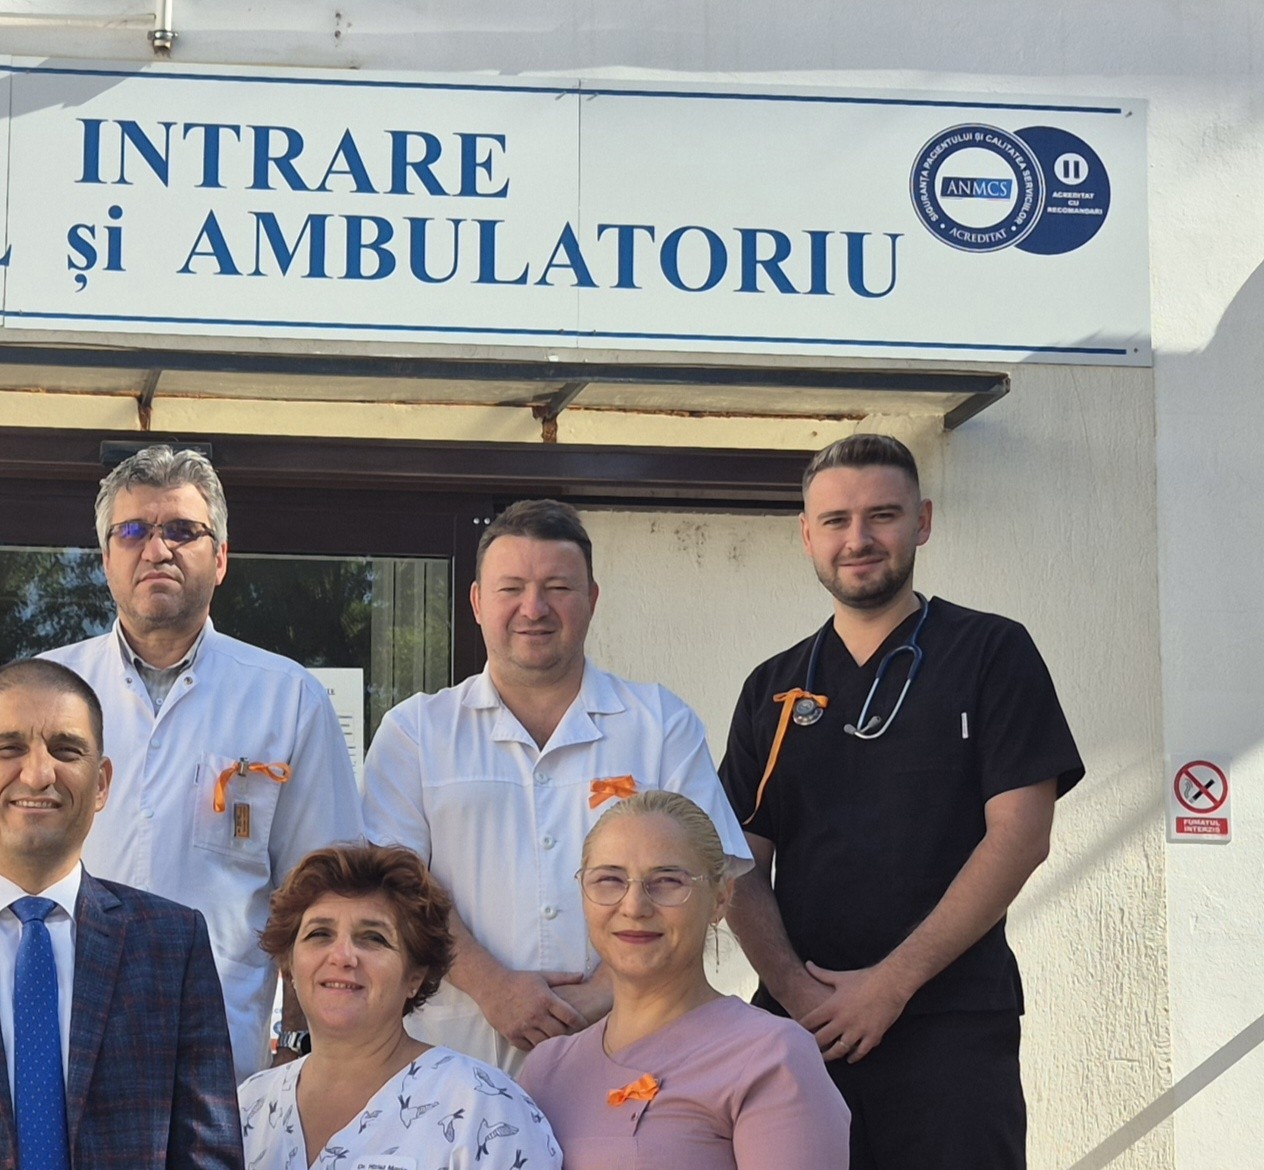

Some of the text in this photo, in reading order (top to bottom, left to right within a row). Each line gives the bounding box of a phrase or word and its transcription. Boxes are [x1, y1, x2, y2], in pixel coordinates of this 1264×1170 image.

[74, 118, 510, 199] INTRARE
[923, 132, 973, 170] PACIENTULUI
[985, 135, 1027, 171] CALITATEA
[946, 180, 1008, 197] ANMCS
[950, 227, 1007, 244] ACREDITAT
[66, 205, 126, 292] și
[176, 209, 905, 298] AMBULATORIU
[1184, 819, 1220, 827] FUMATUL
